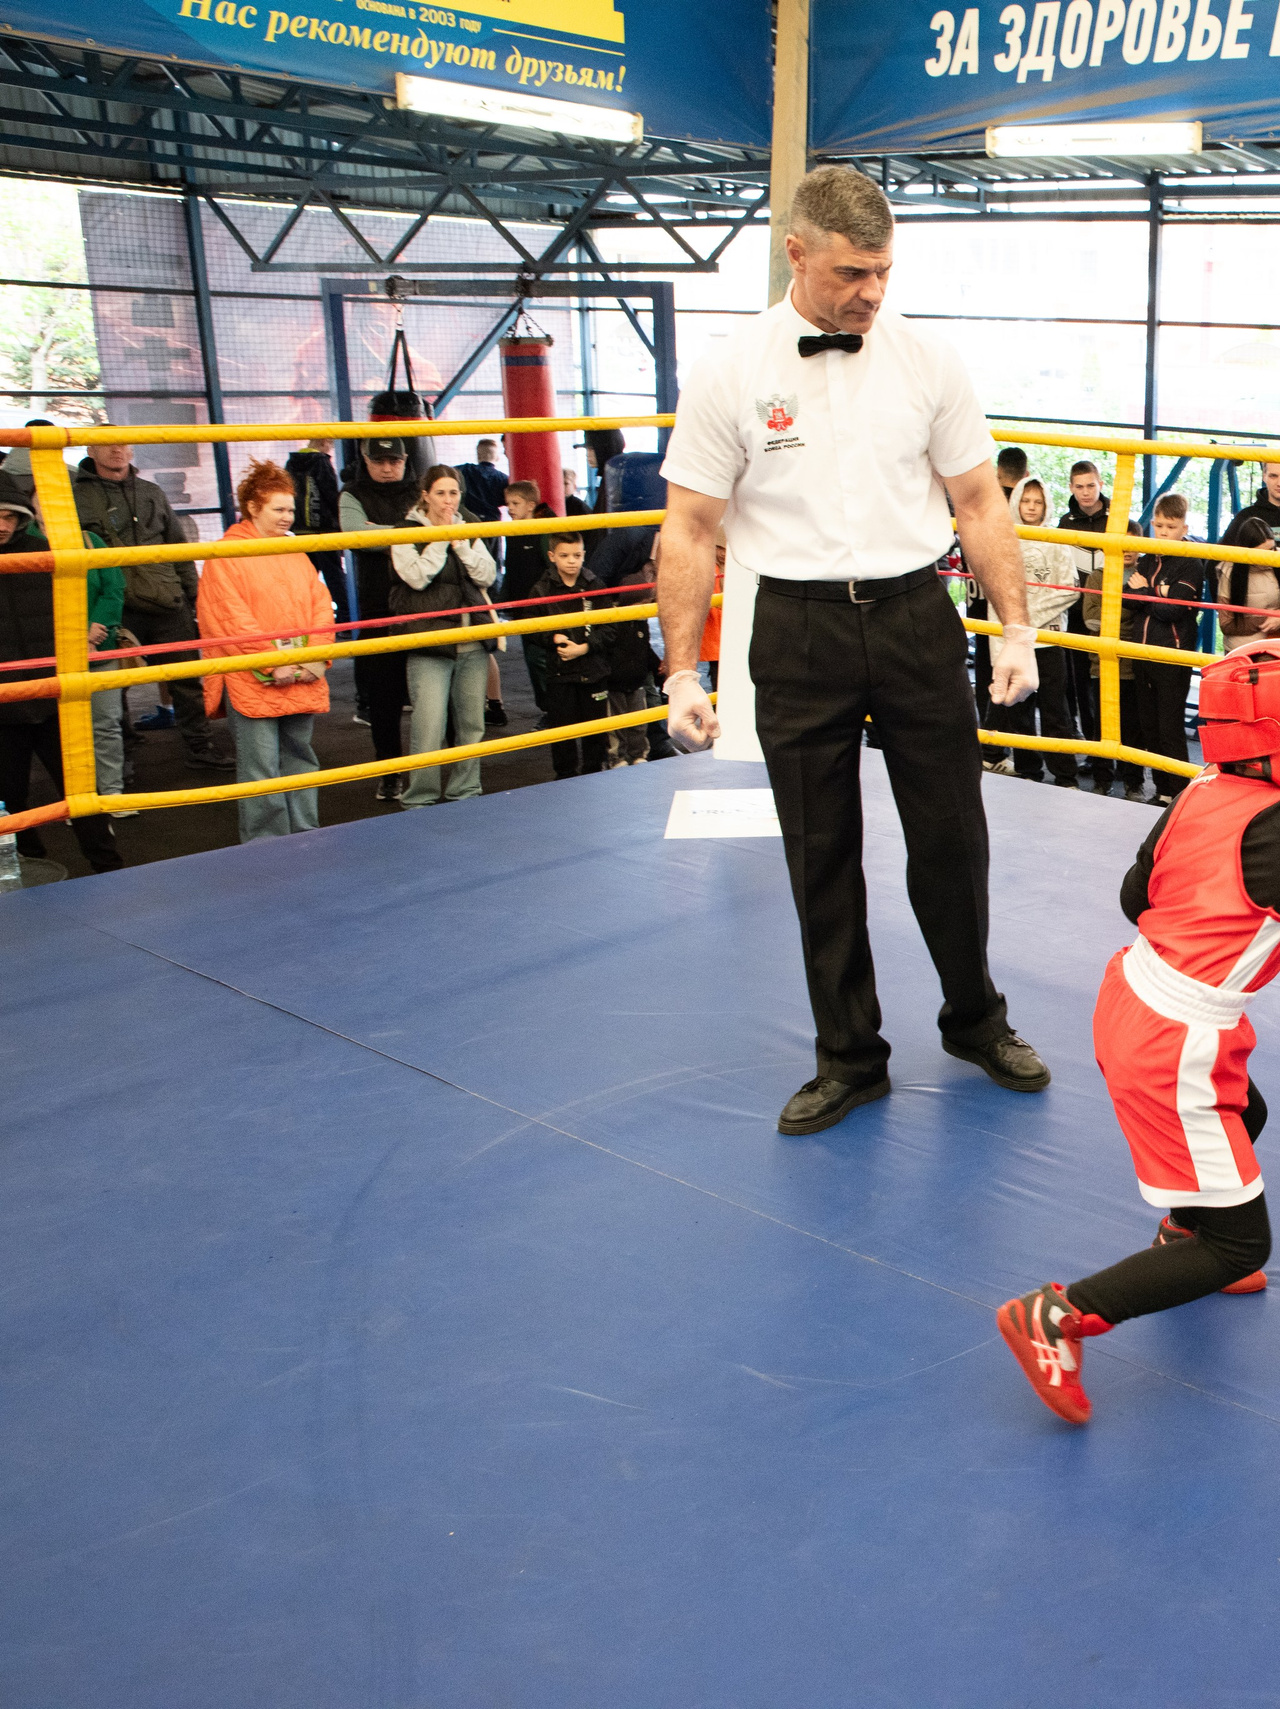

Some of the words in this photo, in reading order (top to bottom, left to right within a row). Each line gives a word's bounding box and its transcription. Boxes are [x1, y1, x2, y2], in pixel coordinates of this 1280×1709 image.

[177, 0, 257, 28] Нас
[264, 10, 496, 69] рекомендуют
[505, 45, 626, 93] друзьям!
[419, 7, 456, 27] 2003
[925, 9, 979, 77] ЗА
[994, 0, 1253, 83] ЗДОРОВЬЕ
